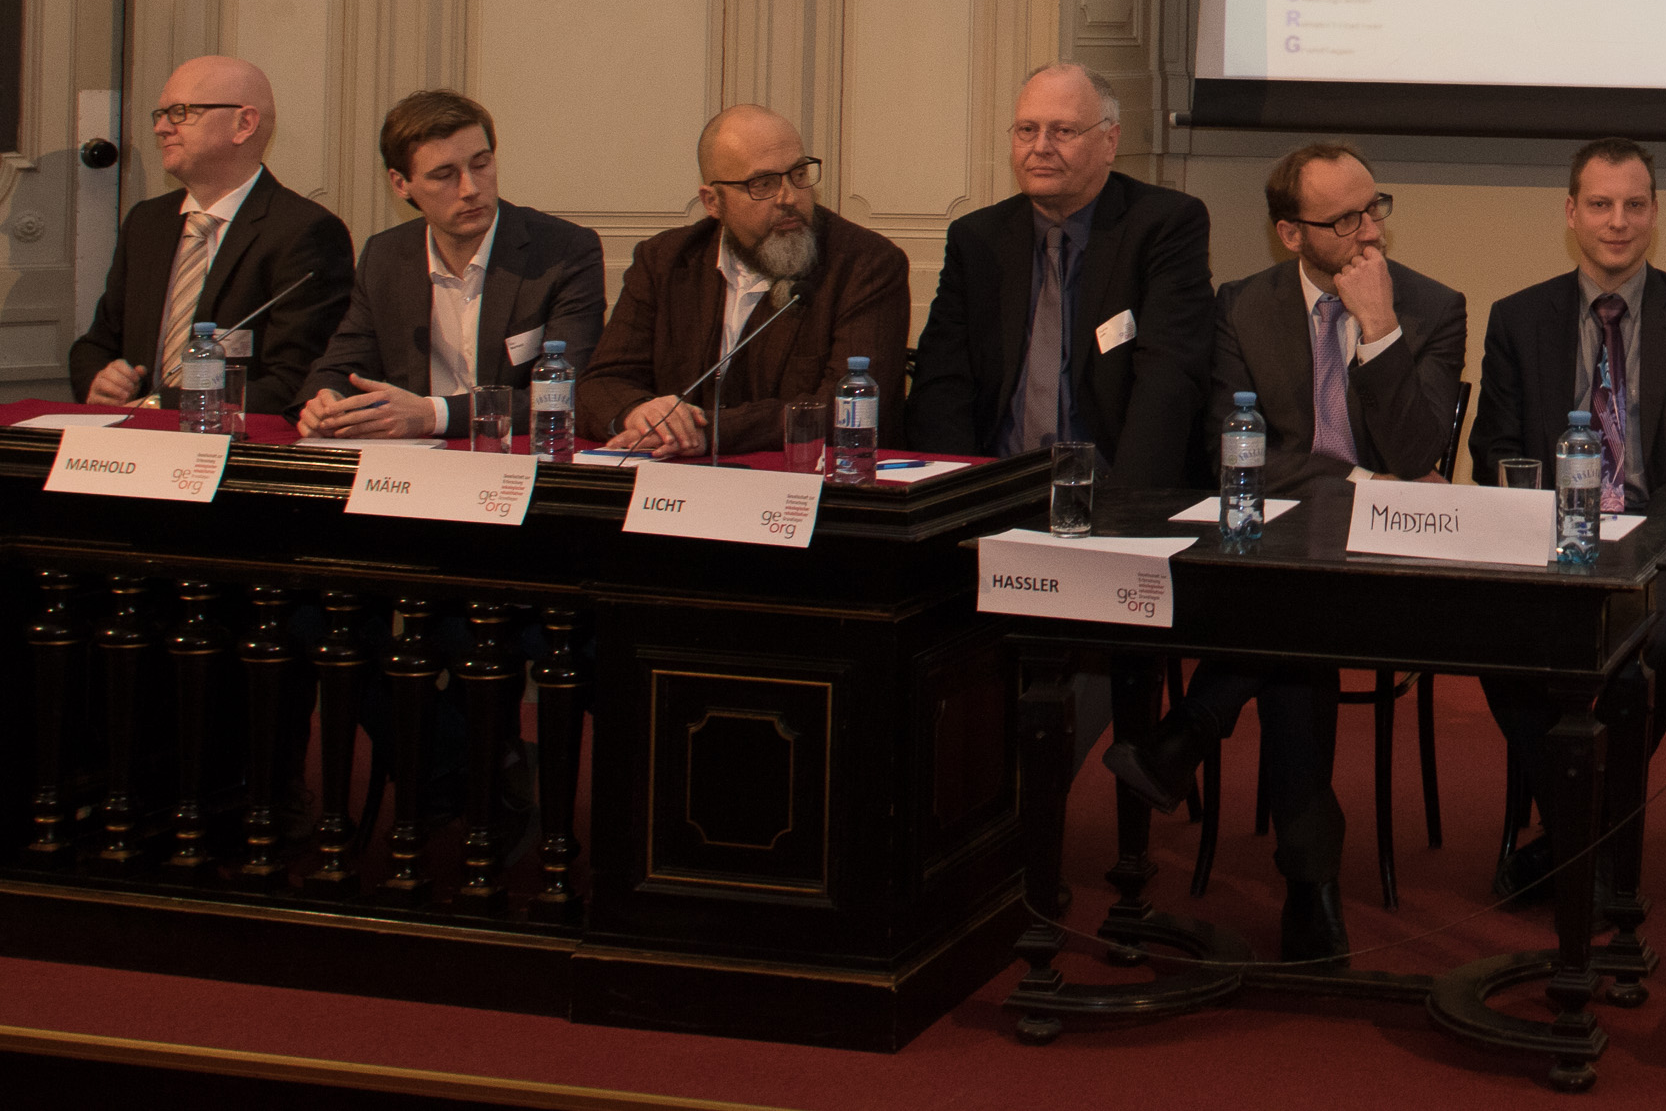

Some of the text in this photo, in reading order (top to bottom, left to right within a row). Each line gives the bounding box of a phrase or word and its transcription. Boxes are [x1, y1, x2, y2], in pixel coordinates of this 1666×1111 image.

[65, 458, 136, 475] MARHOLD
[365, 476, 411, 495] MÄHR
[642, 497, 686, 513] LICHT
[761, 510, 782, 526] ge
[769, 522, 796, 539] org
[992, 574, 1059, 593] HASSLER
[1117, 587, 1137, 603] ge
[1128, 600, 1156, 618] org
